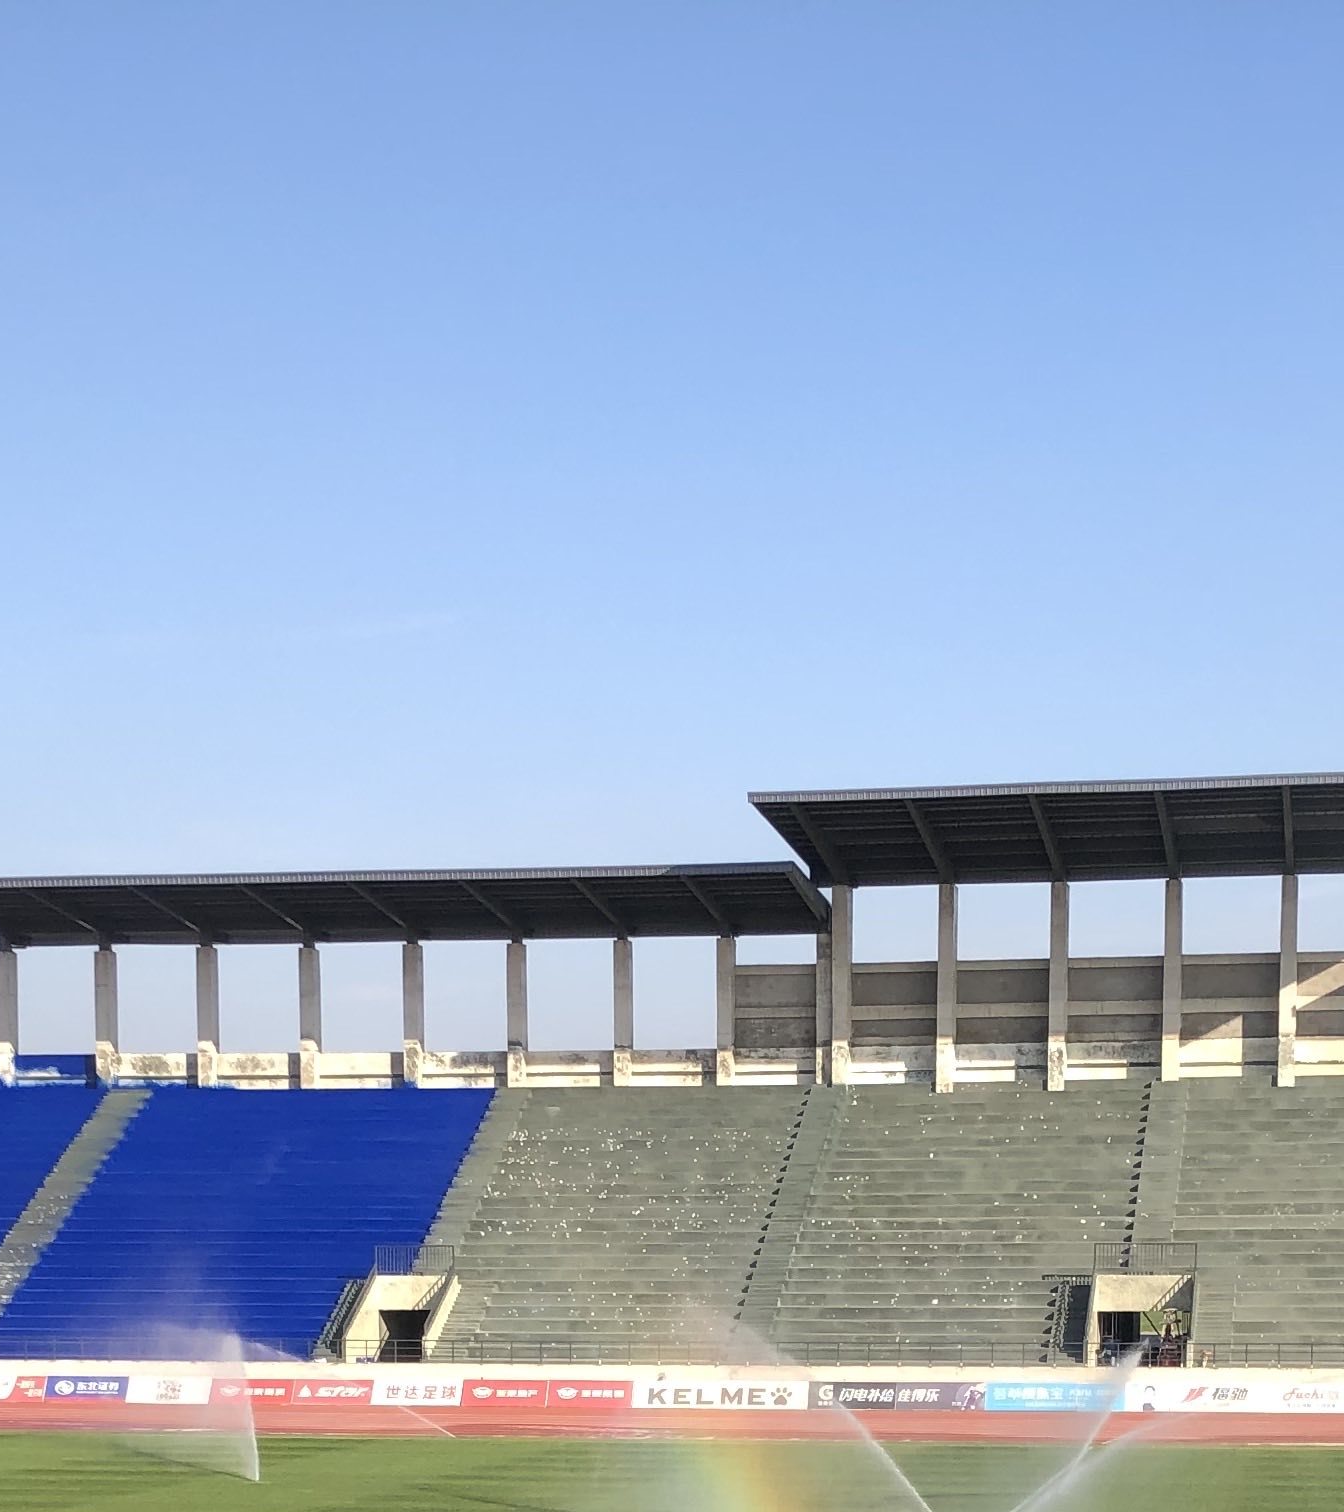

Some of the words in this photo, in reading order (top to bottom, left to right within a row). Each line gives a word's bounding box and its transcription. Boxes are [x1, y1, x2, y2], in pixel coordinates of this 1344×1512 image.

[385, 1384, 457, 1400] 世达足球
[647, 1387, 766, 1406] KELME
